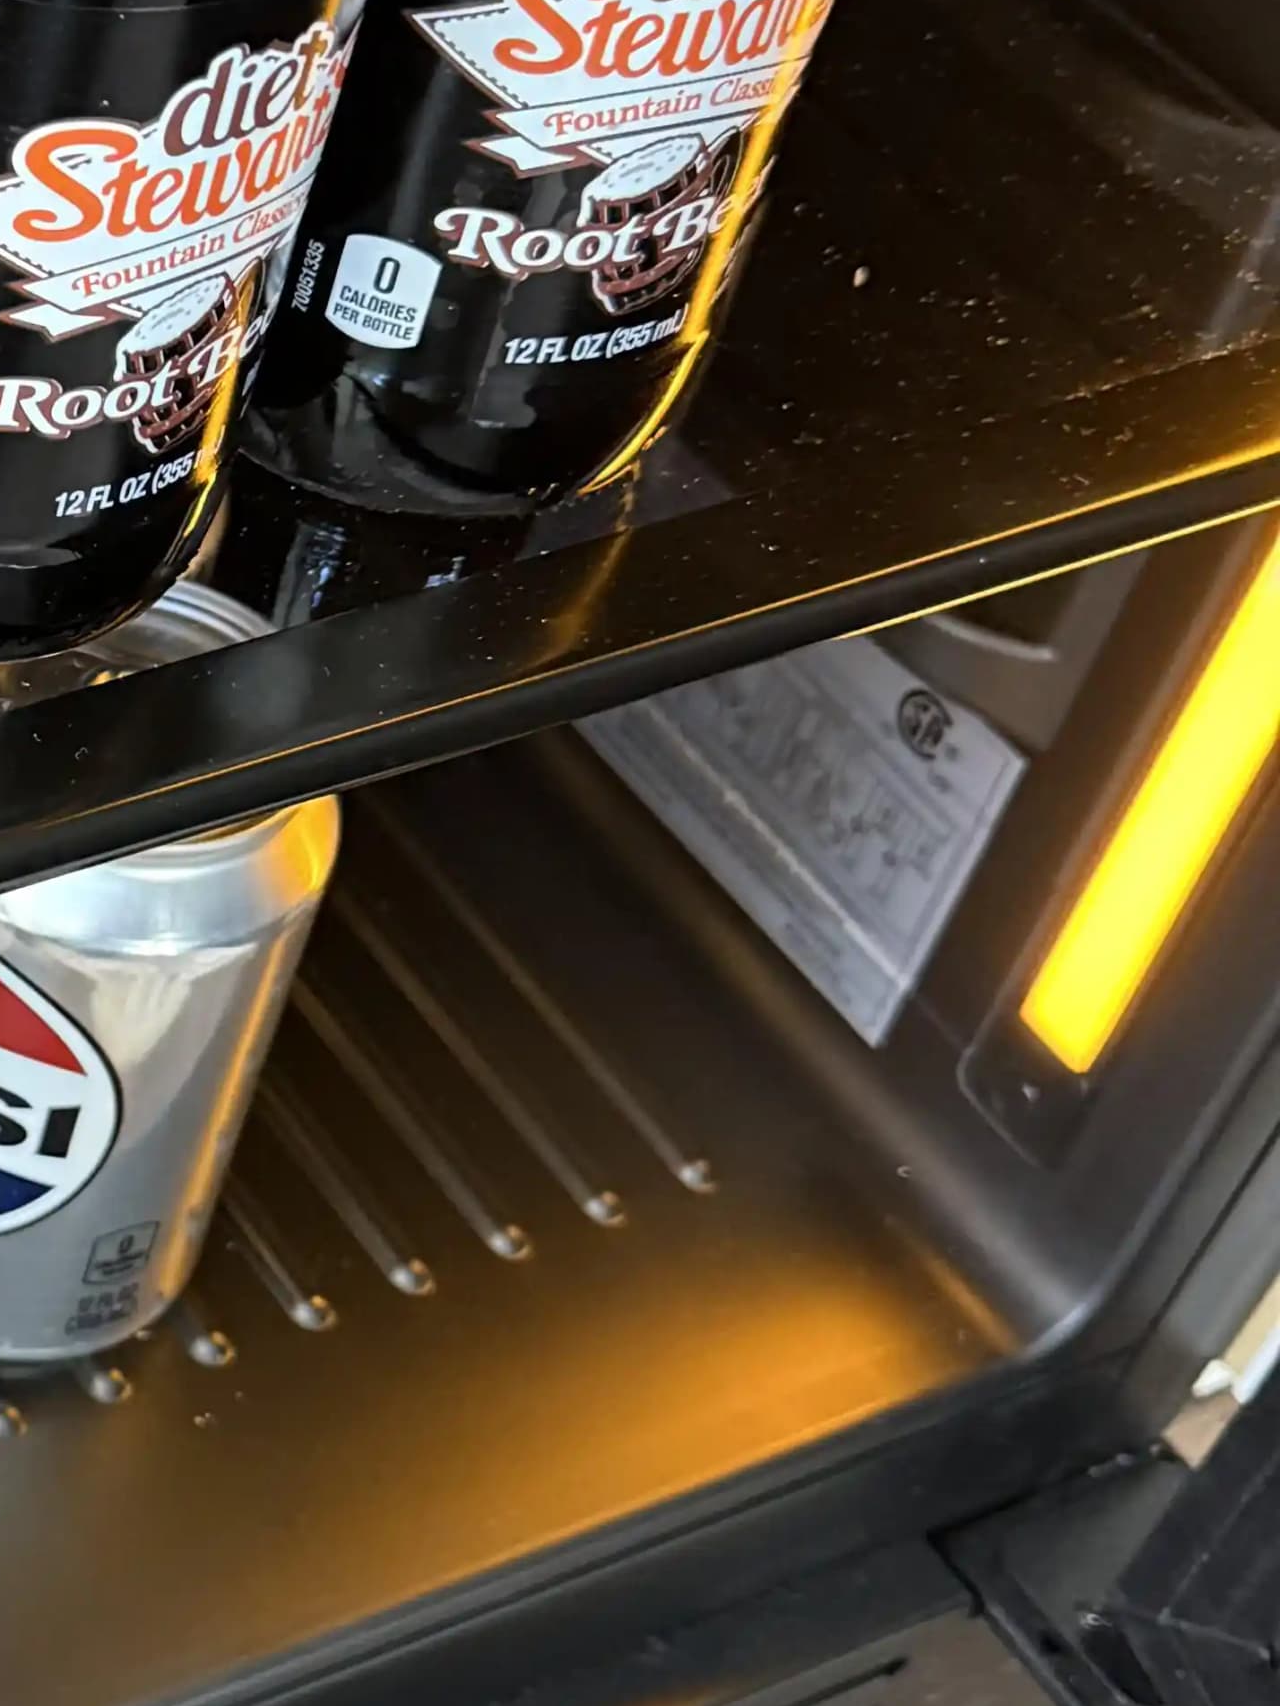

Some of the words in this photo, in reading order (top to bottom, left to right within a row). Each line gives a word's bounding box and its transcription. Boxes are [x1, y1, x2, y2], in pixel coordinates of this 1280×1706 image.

[163, 30, 328, 158] diet
[543, 90, 701, 138] Fountain
[71, 232, 227, 297] Fountain
[433, 206, 647, 281] Root
[290, 238, 326, 313] 70051335
[372, 256, 402, 294] 0
[333, 302, 362, 326] PER
[360, 313, 415, 342] BOTTLE
[339, 284, 417, 324] CALORIES
[504, 337, 538, 365] 12
[539, 335, 569, 364] FL
[572, 331, 603, 360] OZ
[605, 323, 650, 359] (355
[53, 490, 85, 518] 12
[85, 487, 114, 514] FL
[122, 473, 152, 505] OZ
[151, 454, 191, 495] (355
